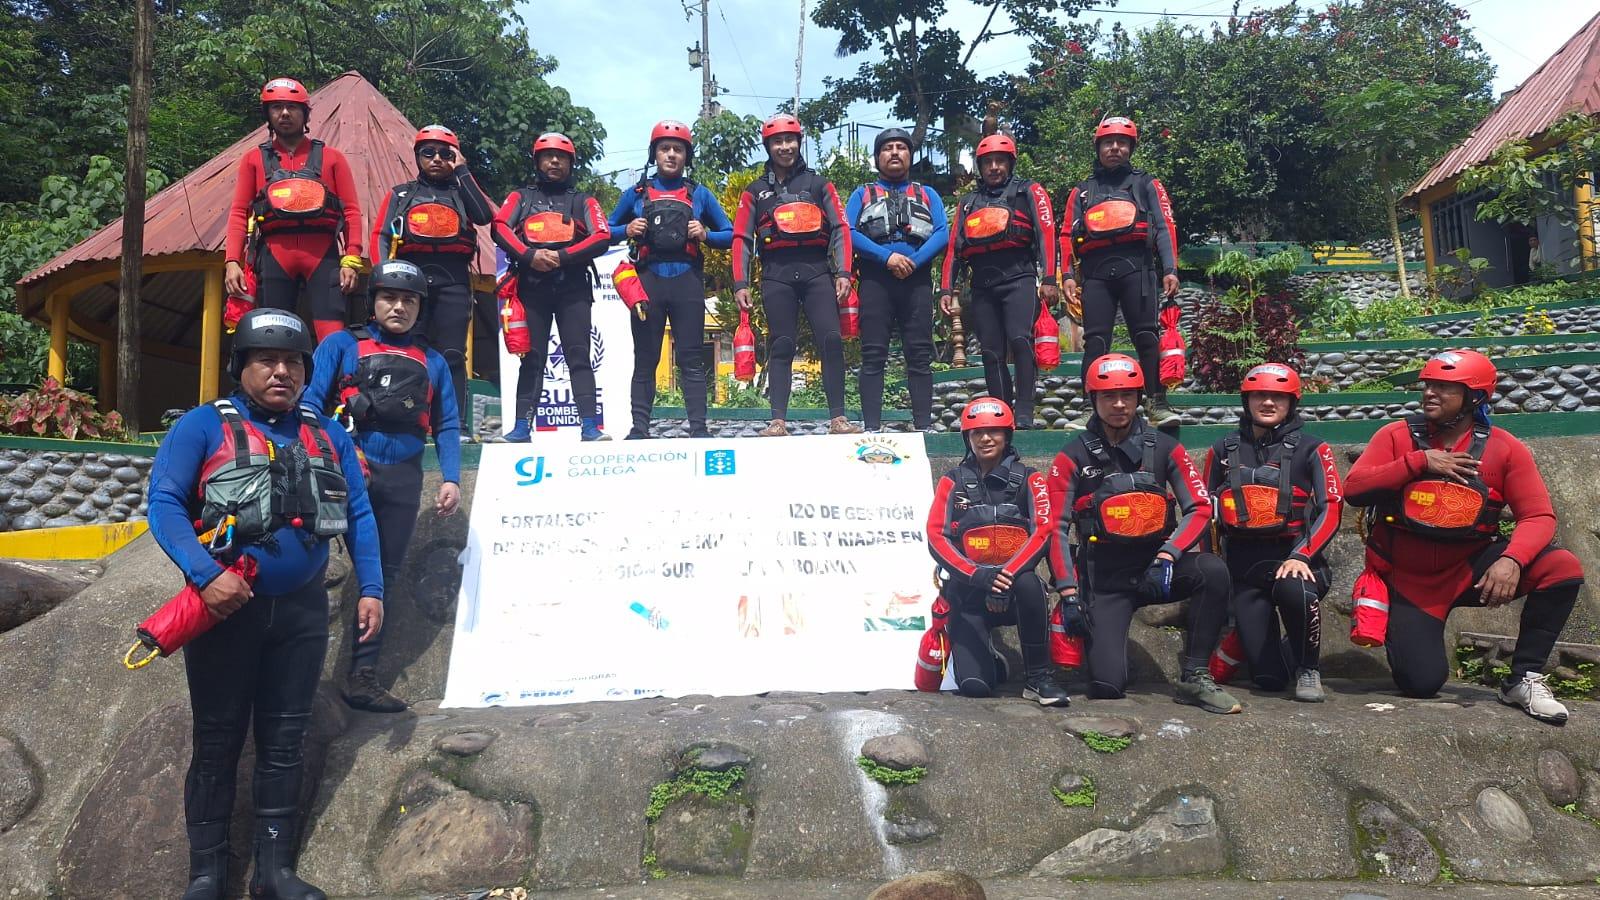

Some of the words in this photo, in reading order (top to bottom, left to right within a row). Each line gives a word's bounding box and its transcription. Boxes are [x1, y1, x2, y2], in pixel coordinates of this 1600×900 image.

[537, 406, 602, 416] BOMBES
[568, 451, 688, 466] COOPERACIÓN
[568, 465, 636, 478] GALEGA
[820, 504, 841, 520] DE
[837, 530, 897, 548] RIADAS
[900, 530, 924, 544] EN
[661, 561, 697, 584] SUR
